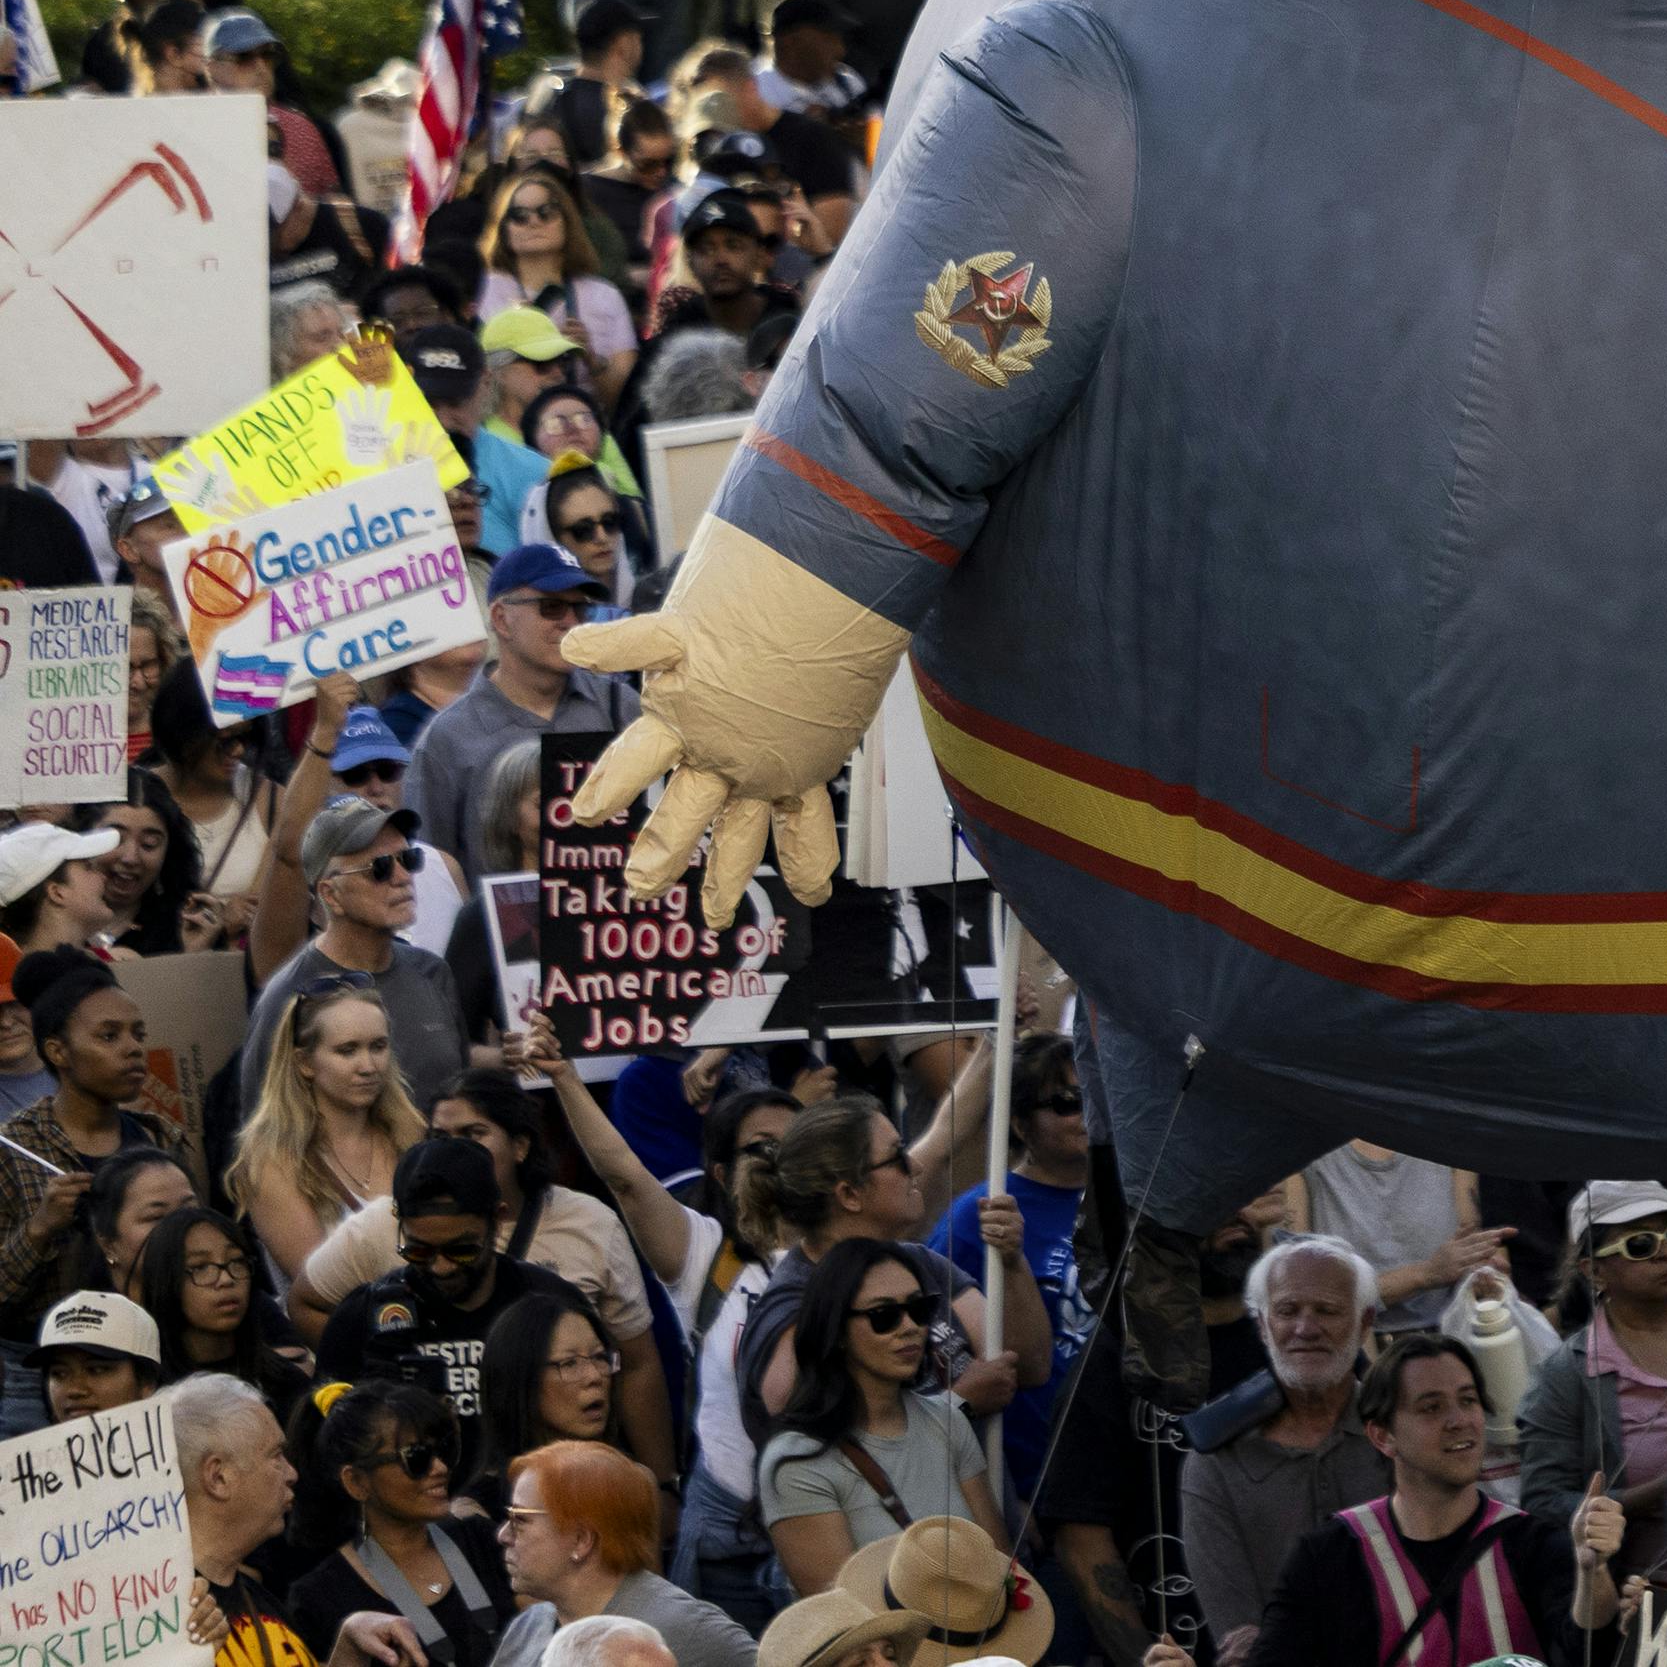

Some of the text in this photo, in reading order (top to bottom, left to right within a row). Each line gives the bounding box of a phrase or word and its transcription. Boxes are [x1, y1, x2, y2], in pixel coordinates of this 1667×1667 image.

[213, 374, 337, 468] HANDS
[265, 428, 321, 489] OFF
[254, 503, 438, 586] Gender-
[31, 597, 119, 627] MEDICAL
[269, 543, 467, 643] Affirming
[29, 624, 128, 660] RESEARCH
[303, 618, 413, 679] Care
[28, 662, 122, 700] LIBRARIES
[28, 704, 122, 742] SOCIAL
[345, 723, 384, 740] Getty
[24, 743, 127, 777] SECURITY
[580, 916, 788, 961] 1000s of
[543, 964, 768, 1009] American
[582, 1005, 692, 1052] Jobs
[11, 1451, 63, 1503] the
[12, 1558, 178, 1631] has NO KING
[102, 1596, 180, 1663] ELON
